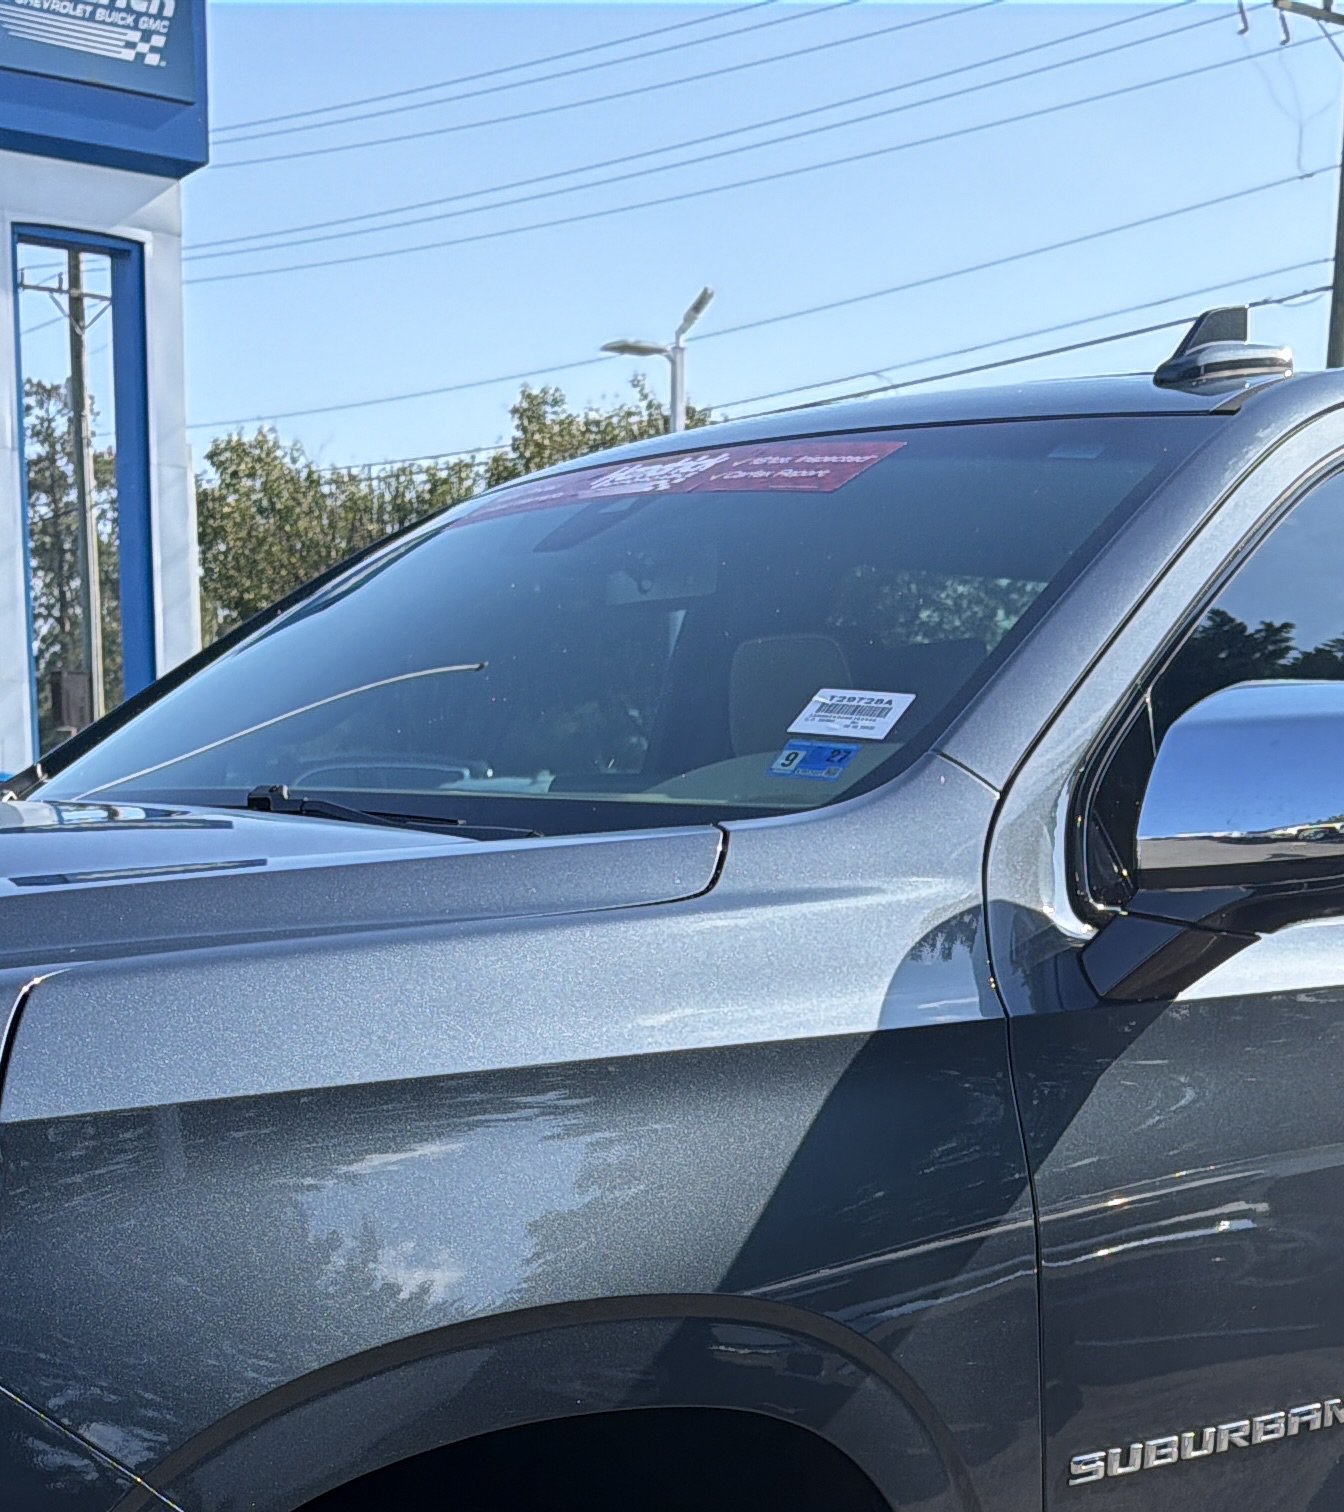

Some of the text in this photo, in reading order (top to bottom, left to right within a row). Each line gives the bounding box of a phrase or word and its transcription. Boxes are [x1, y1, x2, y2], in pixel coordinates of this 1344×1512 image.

[94, 8, 135, 27] BUICK
[138, 16, 171, 33] GMC
[780, 749, 852, 768] 9 27
